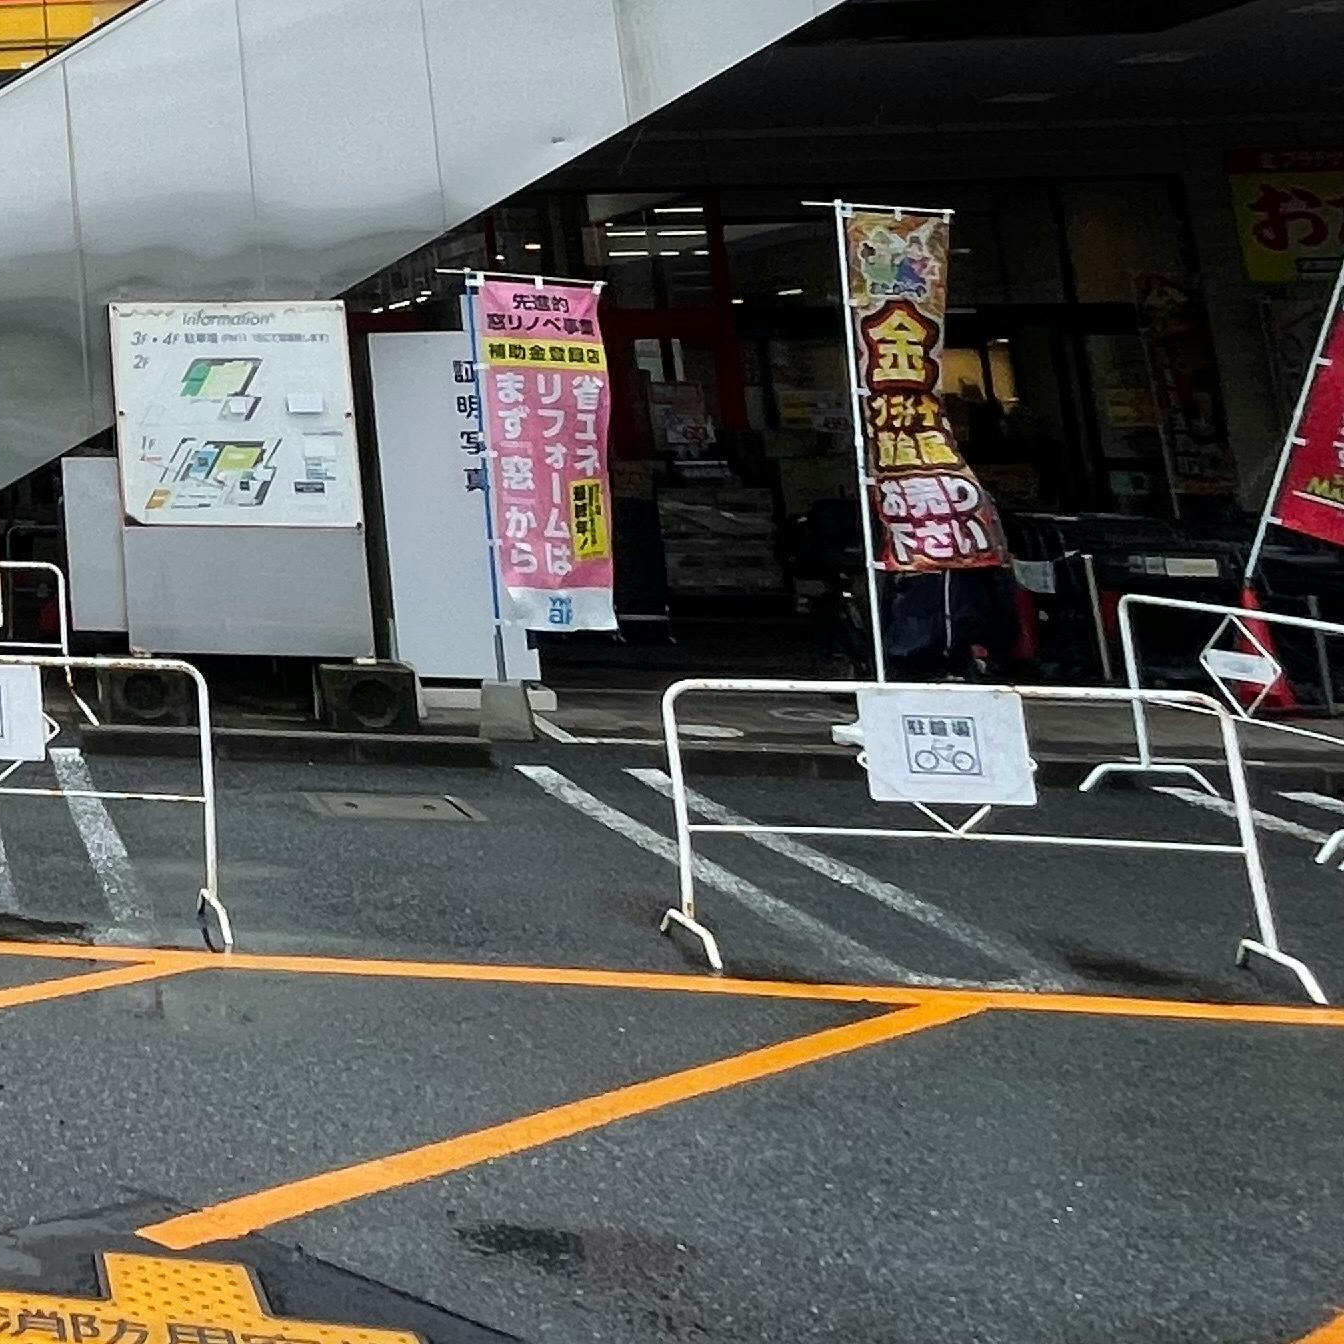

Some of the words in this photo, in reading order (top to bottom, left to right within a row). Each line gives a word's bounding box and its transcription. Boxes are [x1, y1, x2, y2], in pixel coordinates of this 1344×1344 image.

[868, 308, 929, 384] 金
[535, 373, 573, 576] リフォームは
[880, 475, 979, 519] お売り
[887, 519, 990, 562] 下さい
